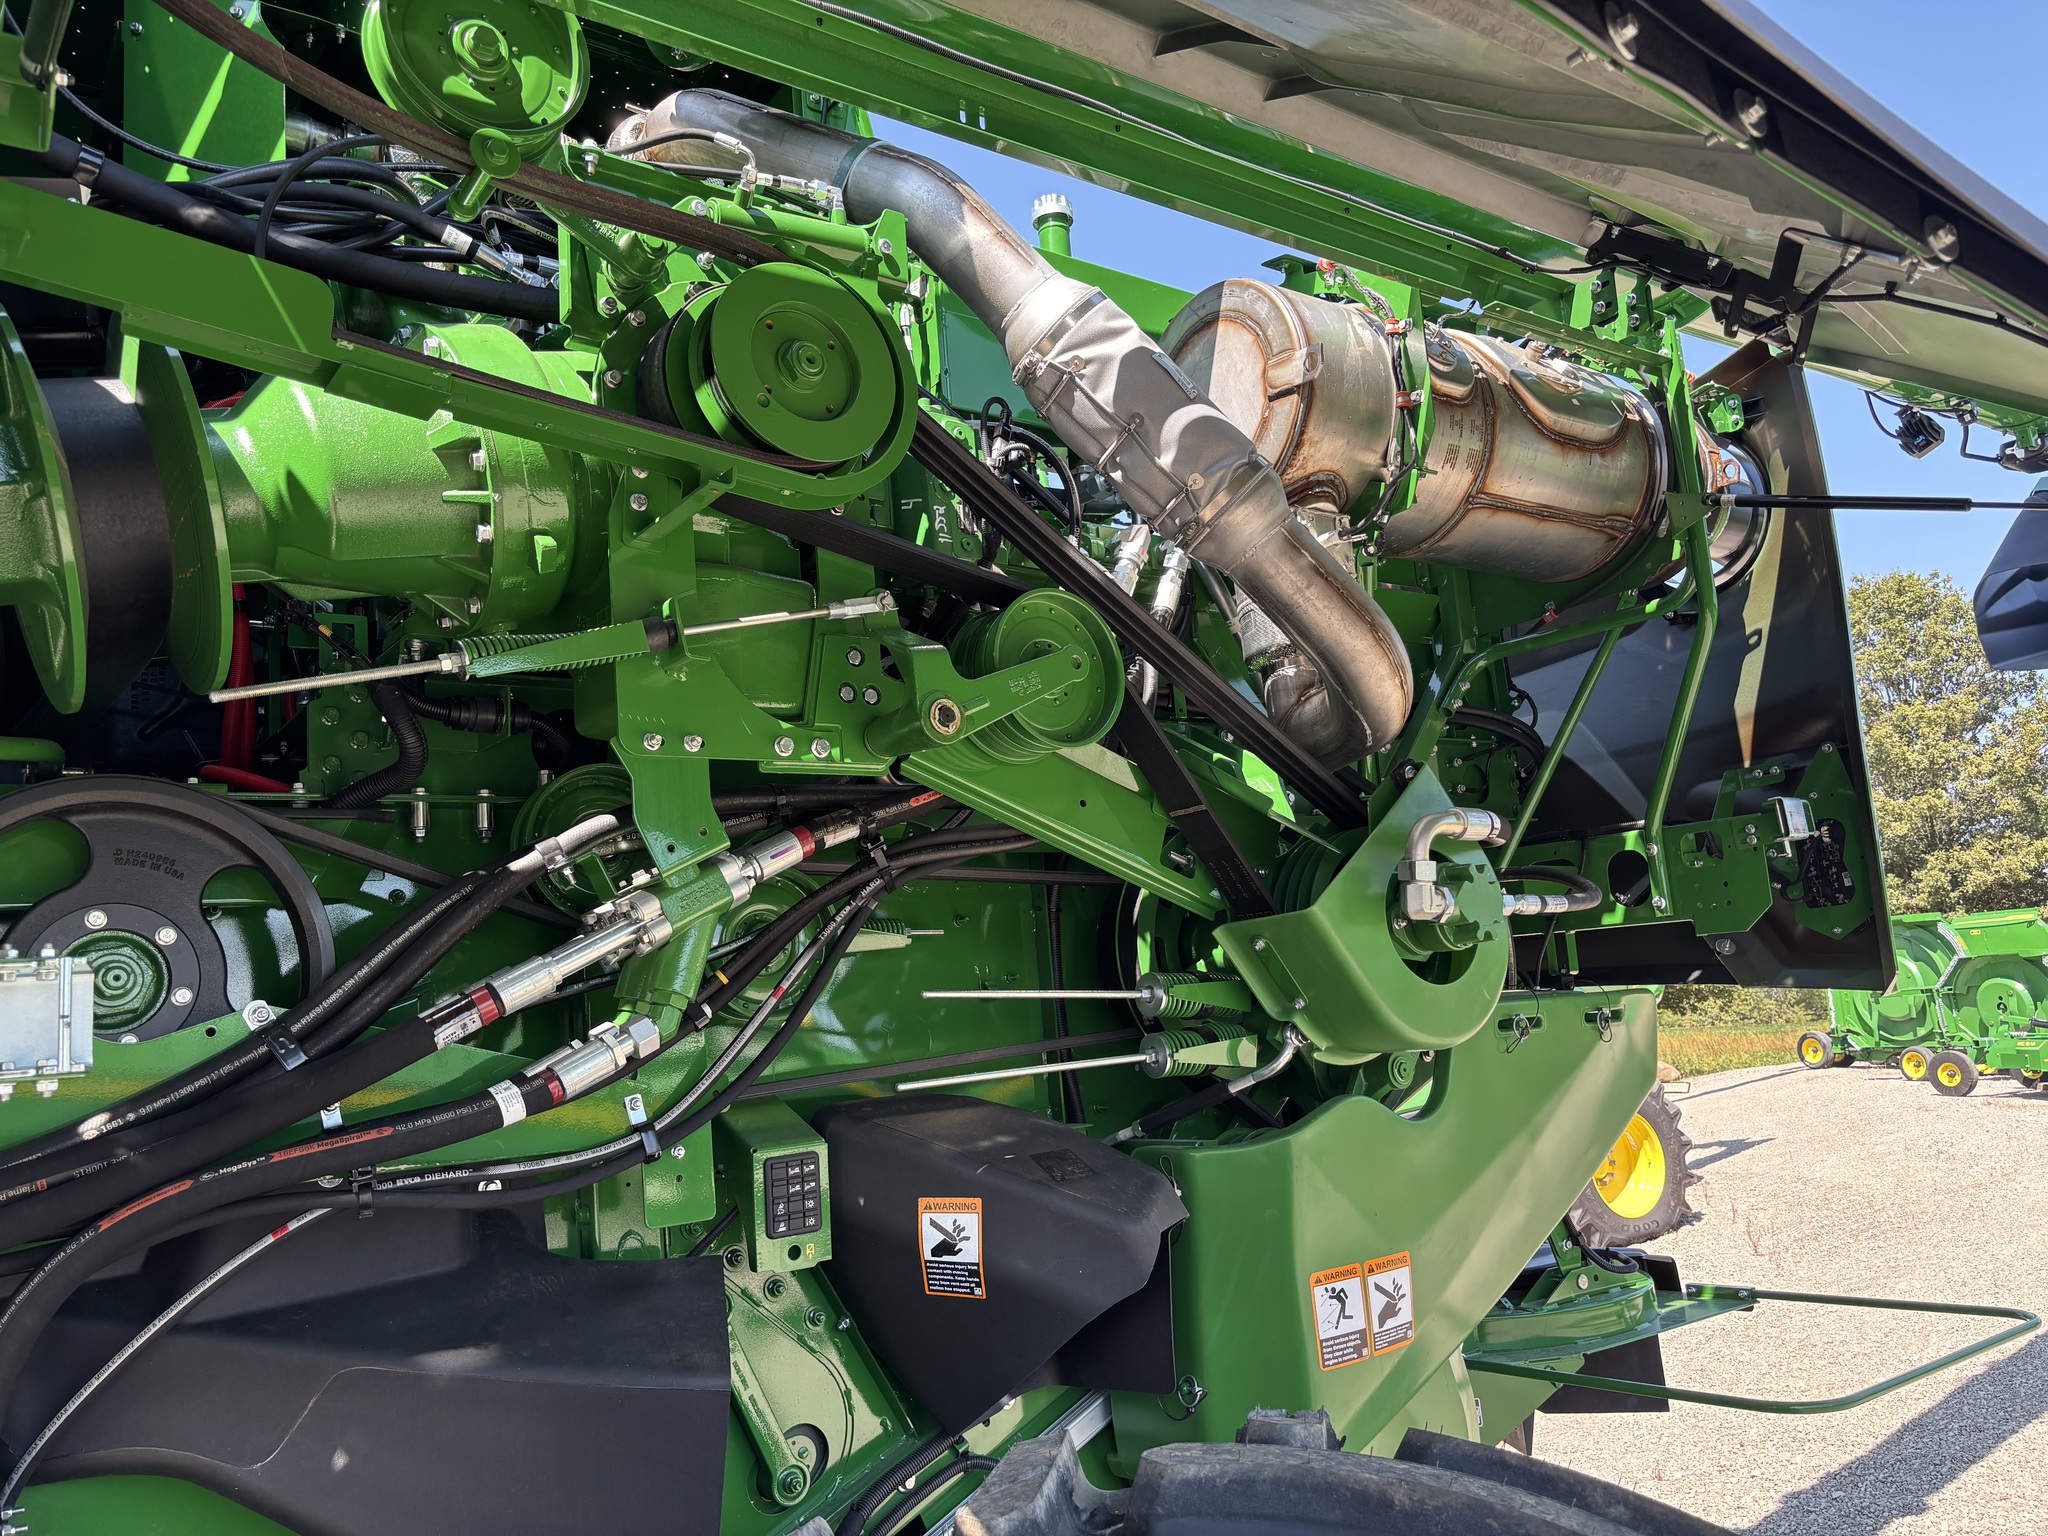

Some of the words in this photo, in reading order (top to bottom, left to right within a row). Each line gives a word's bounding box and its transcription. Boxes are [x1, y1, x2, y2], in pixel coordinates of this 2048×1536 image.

[114, 857, 146, 869] MADE
[149, 861, 162, 872] IN
[164, 866, 185, 881] USA
[357, 965, 370, 978] SAE
[392, 931, 411, 948] Flame
[409, 907, 435, 933] Resistant
[435, 898, 452, 914] MSHA
[818, 921, 836, 941] T3000
[705, 1058, 727, 1084] ABRASION
[725, 1033, 747, 1060] RESISTANT
[139, 1103, 153, 1116] 9.0
[153, 1096, 171, 1108] MPa
[171, 1084, 194, 1102] (1300
[194, 1074, 212, 1089] PSI)
[220, 1060, 240, 1077] (25.4
[240, 1049, 259, 1064] mm)
[395, 1122, 414, 1131] 42.0
[414, 1117, 432, 1127] MPa
[432, 1110, 455, 1123] (6000
[454, 1104, 472, 1115] PSI)
[519, 1083, 532, 1093] SO
[517, 1160, 546, 1170] T3008D
[933, 1202, 977, 1211] WARNING
[14, 1271, 45, 1305] Resistant
[44, 1251, 66, 1273] MSHA
[65, 1228, 96, 1253] 2G-11C
[1375, 1255, 1407, 1271] WARNING
[1323, 1267, 1358, 1280] WARNING
[56, 1406, 69, 1421] BAR
[83, 1381, 95, 1393] PSI
[135, 1327, 152, 1343] FRAS
[157, 1295, 189, 1323] ABRASION
[188, 1269, 222, 1298] RESISTANT
[1322, 1339, 1334, 1347] Avoid
[1334, 1336, 1349, 1344] serious
[1348, 1333, 1360, 1341] injury
[1324, 1352, 1333, 1360] Stay
[1324, 1358, 1338, 1366] engine
[1342, 1353, 1358, 1361] running.
